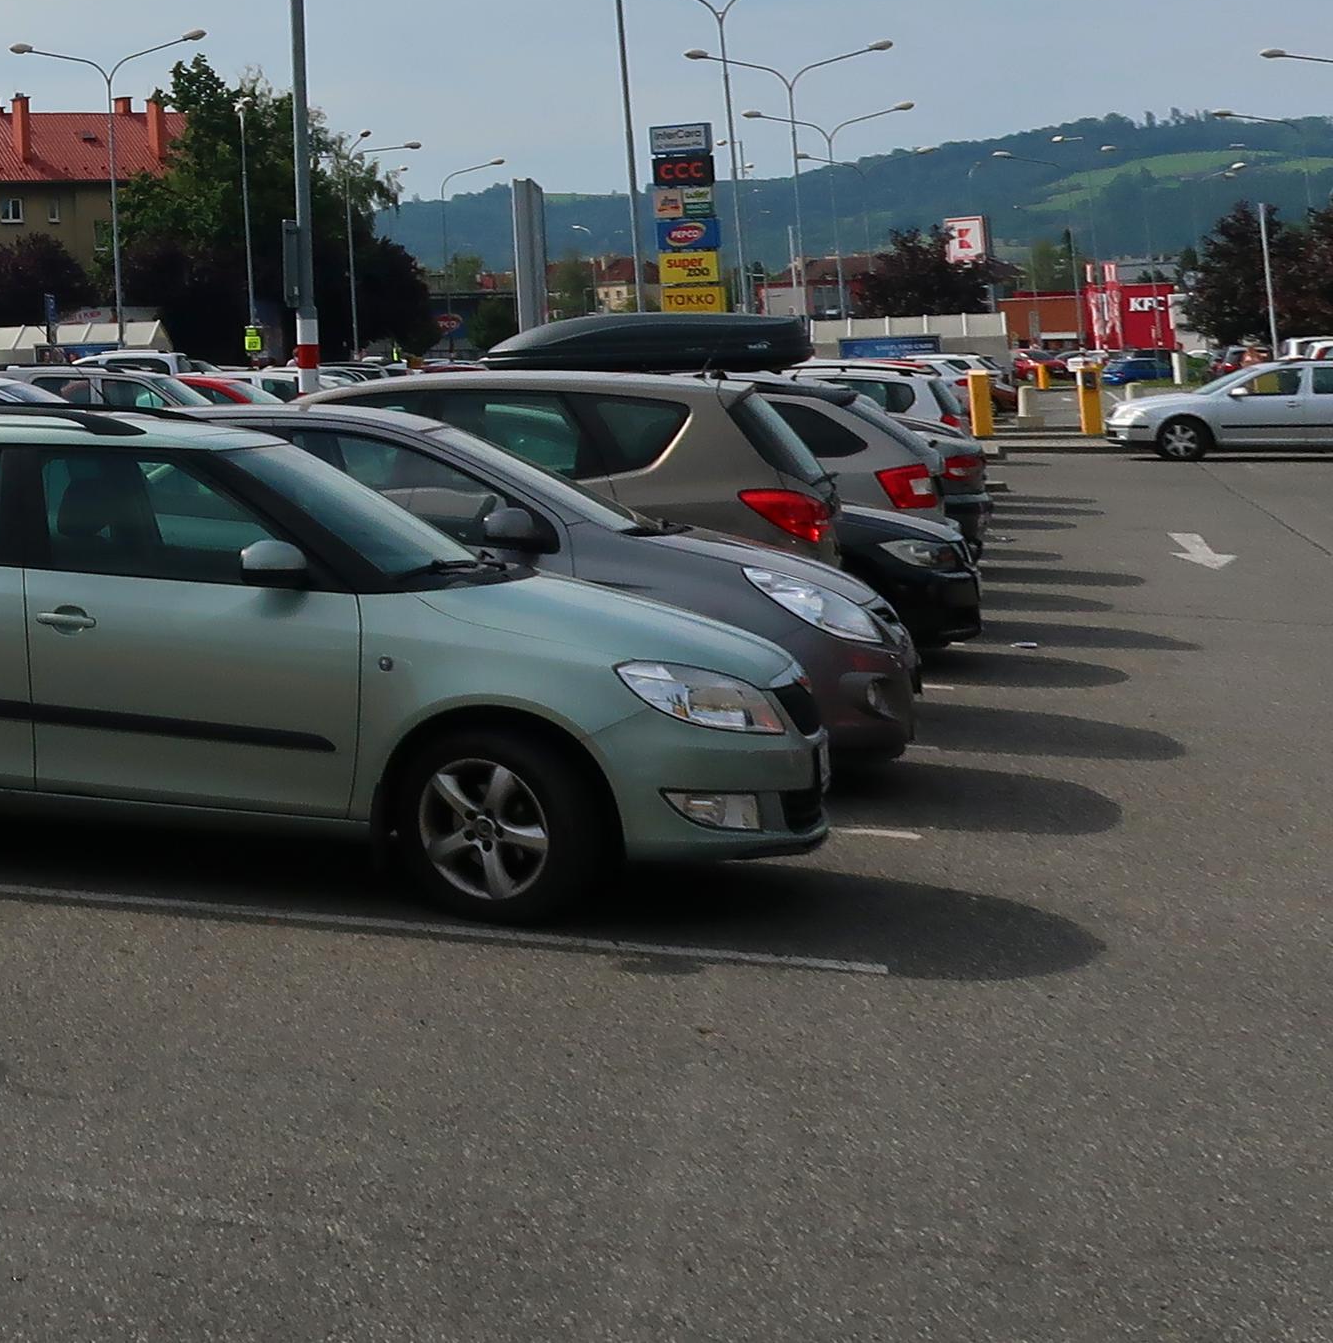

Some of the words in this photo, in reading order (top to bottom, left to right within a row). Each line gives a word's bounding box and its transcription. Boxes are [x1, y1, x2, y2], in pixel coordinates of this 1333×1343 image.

[659, 161, 705, 179] CCC
[670, 229, 700, 238] PEPCO
[666, 258, 704, 270] super
[1129, 296, 1165, 312] KFC
